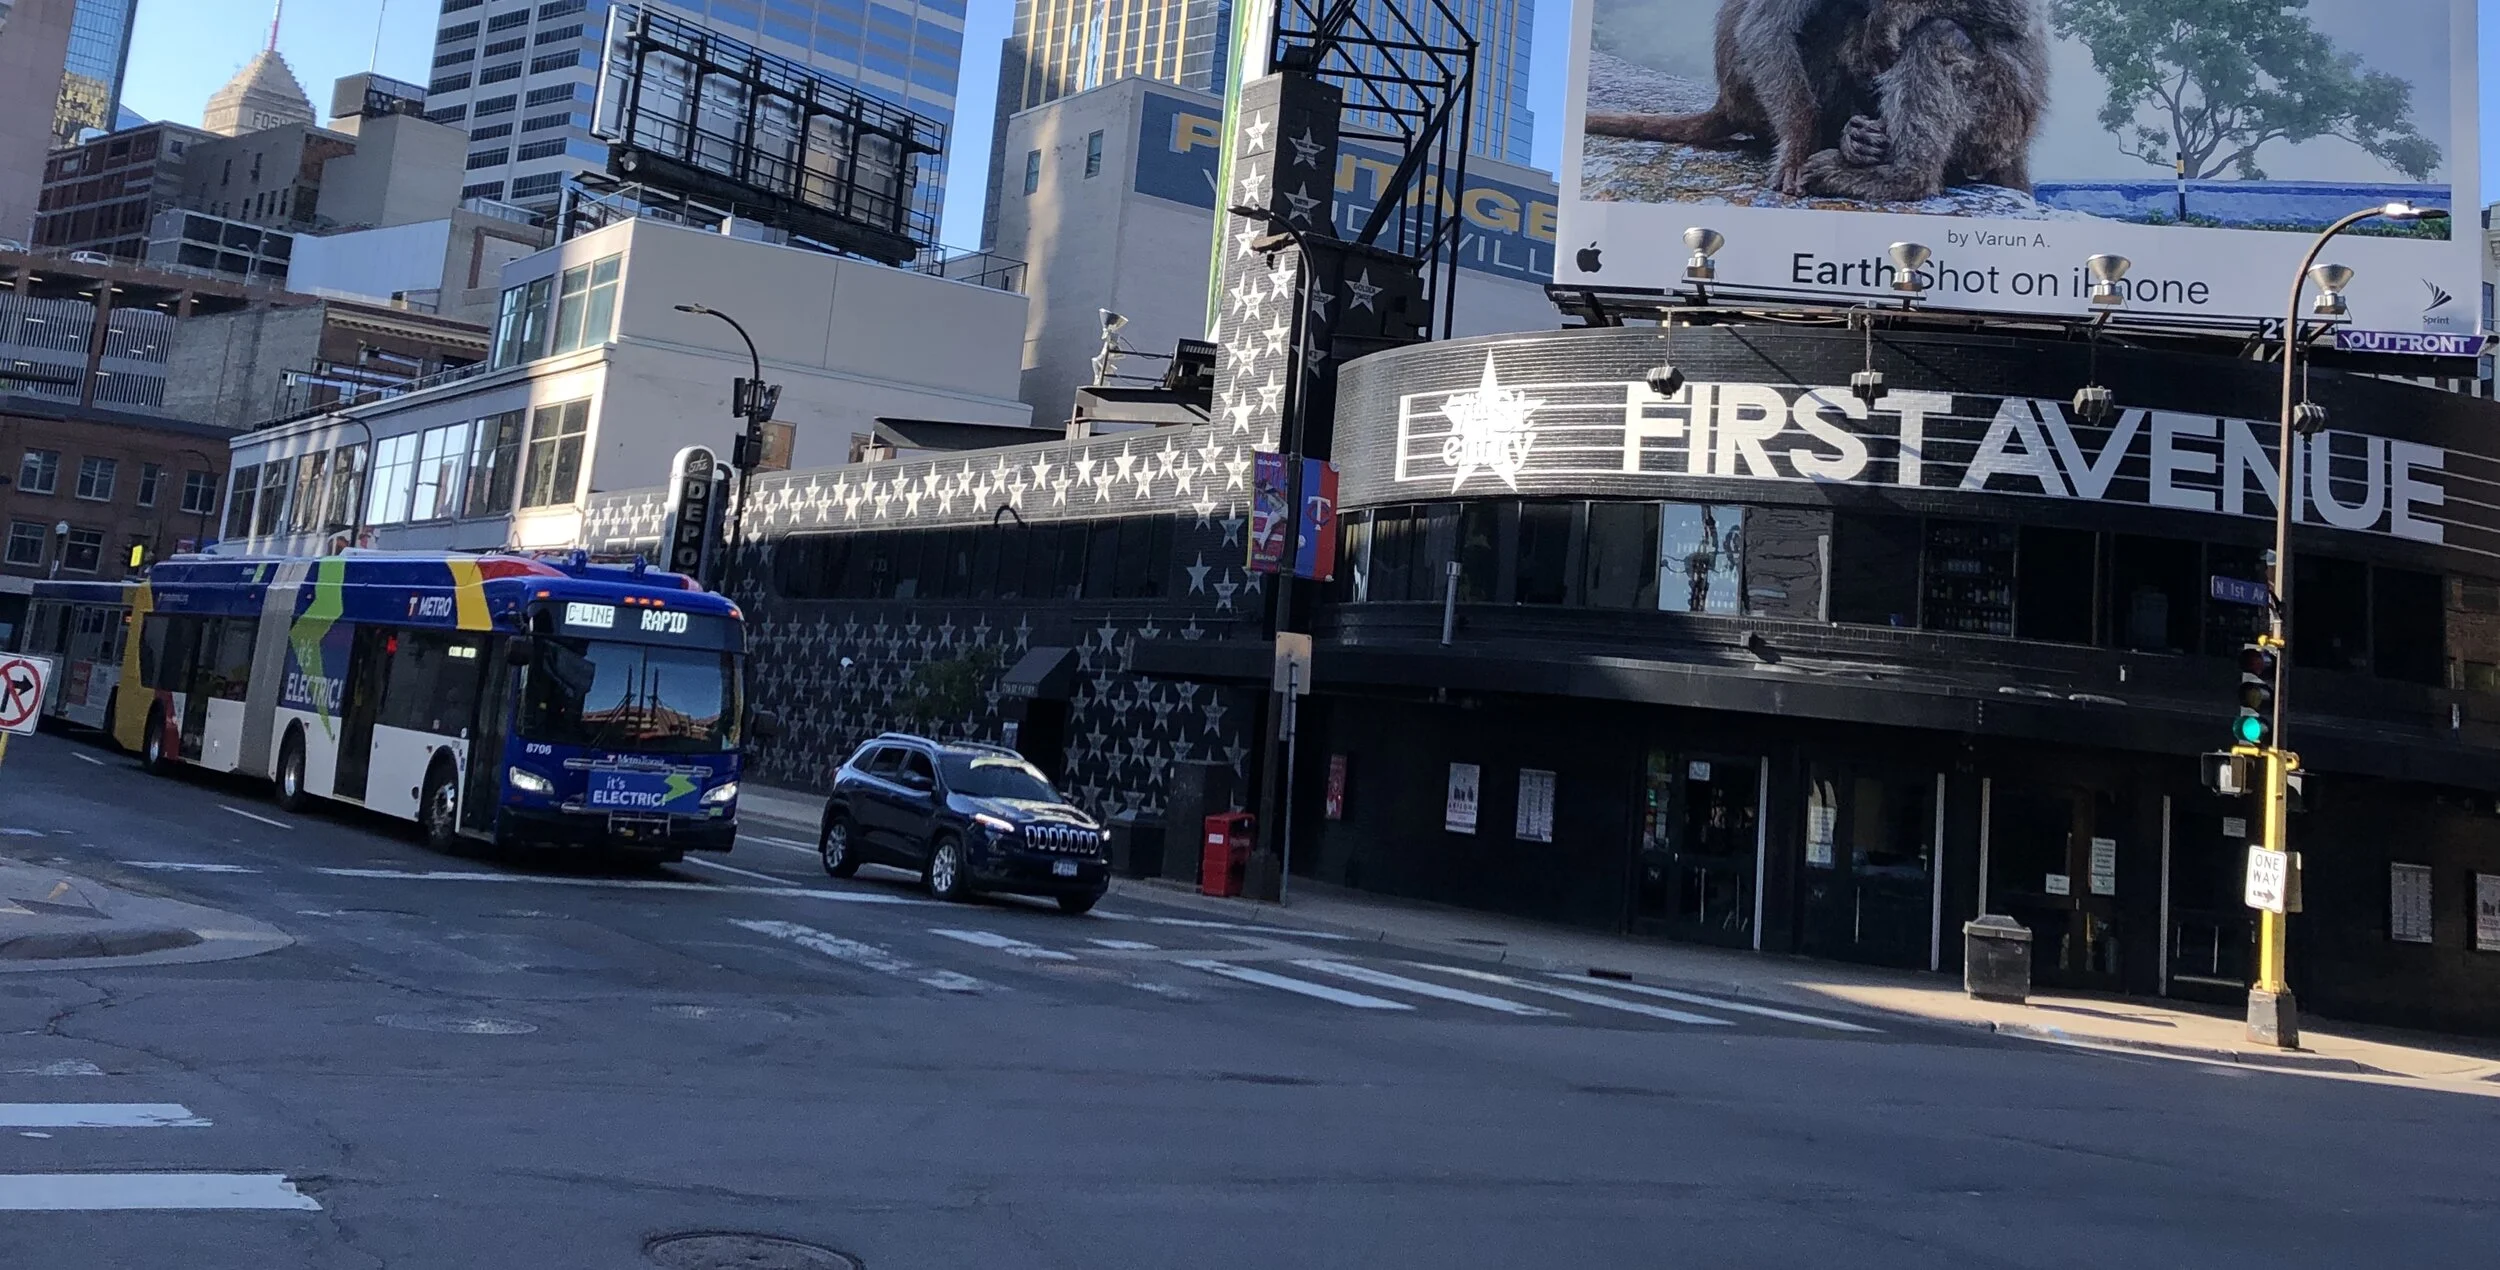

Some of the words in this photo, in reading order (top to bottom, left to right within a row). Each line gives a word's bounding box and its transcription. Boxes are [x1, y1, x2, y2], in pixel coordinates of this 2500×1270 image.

[1947, 229, 1969, 247] by
[1975, 230, 2027, 246] Varun
[2033, 233, 2051, 248] A.
[1792, 252, 1896, 288] Earth
[1917, 258, 2000, 294] Shot
[2011, 271, 2059, 297] on
[2423, 316, 2450, 326] Sprint
[2349, 331, 2471, 353] OUTFRONT
[1623, 382, 1952, 487] FIRST
[1960, 396, 2445, 546] AVENUE
[2216, 581, 2224, 595] N
[2230, 583, 2245, 599] 1st
[419, 596, 453, 617] METRO
[568, 604, 577, 621] C
[581, 605, 613, 624] LINE
[640, 609, 689, 634] RAPID
[285, 673, 344, 710] ELECTRIC!
[607, 776, 626, 790] it's
[593, 790, 666, 807] ELECTRIC!
[2255, 854, 2280, 871] ONE
[2253, 869, 2280, 887] WAY
